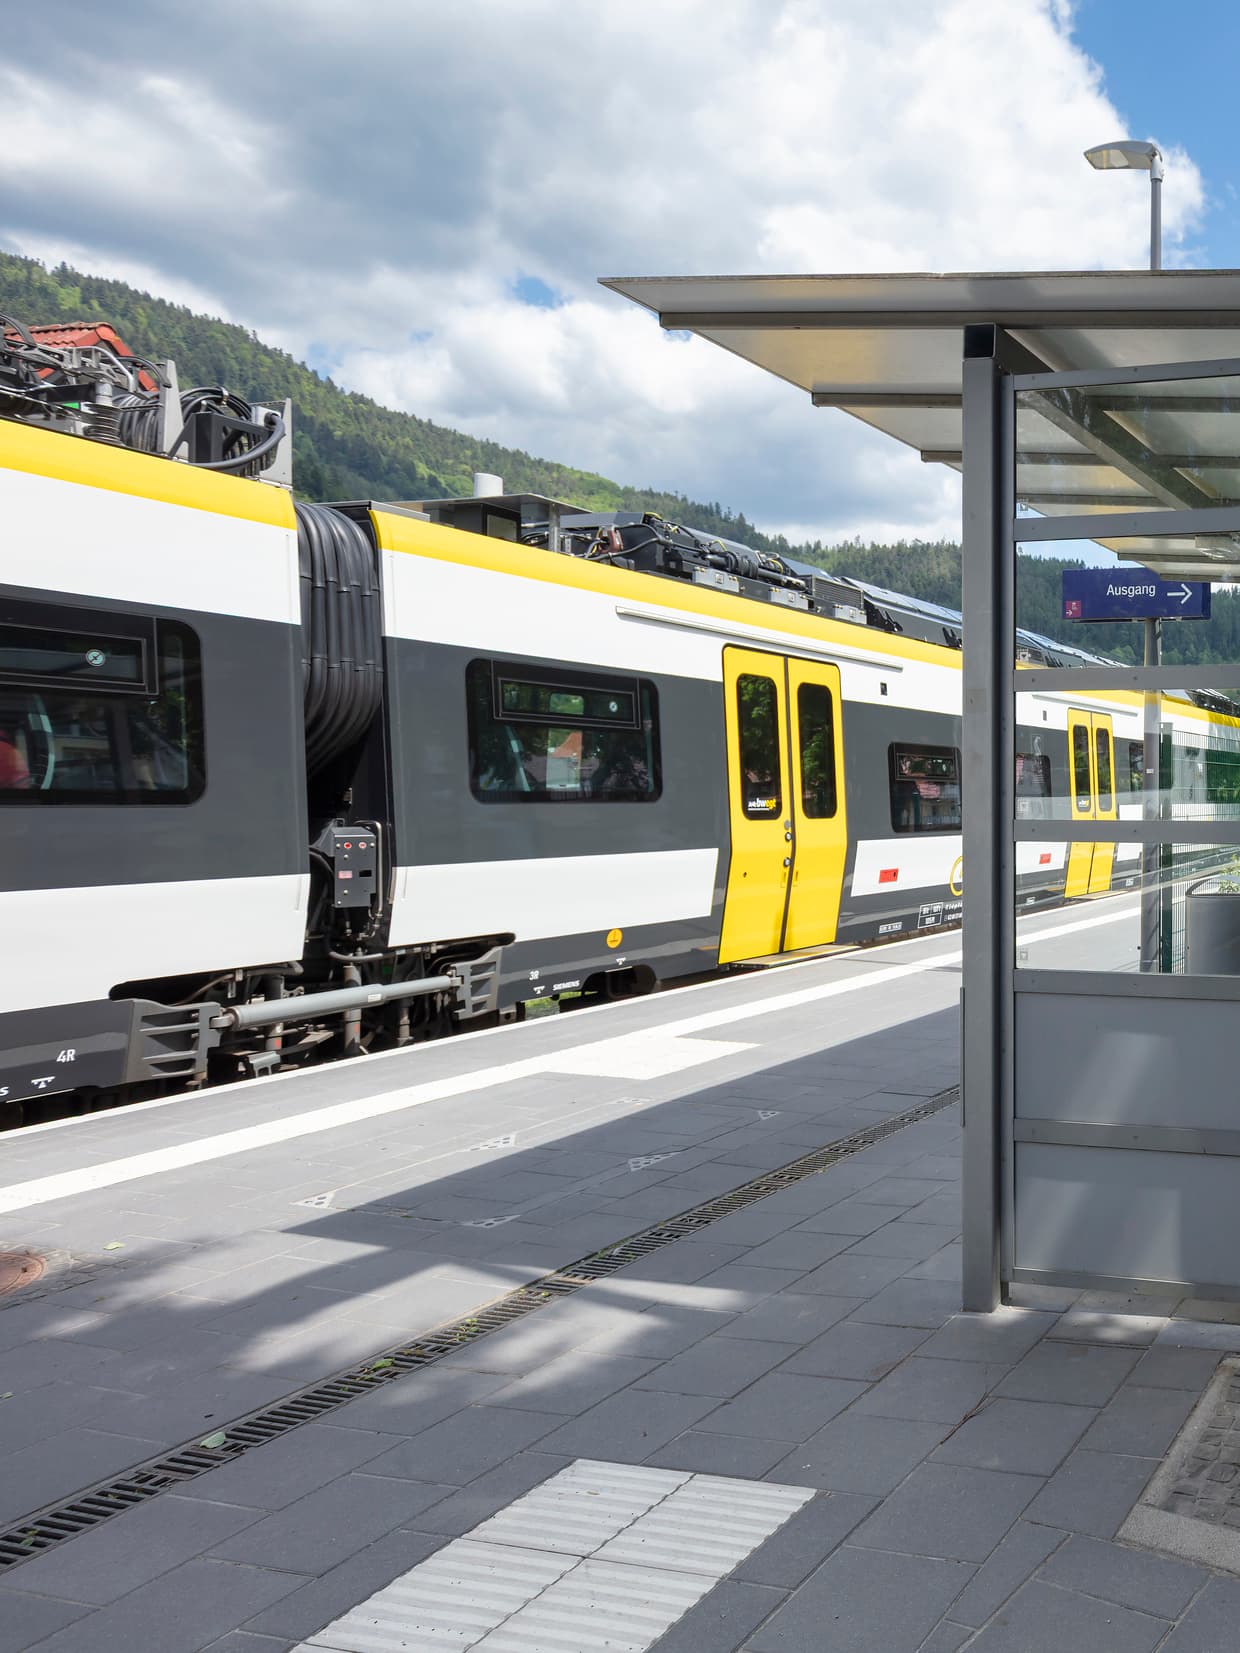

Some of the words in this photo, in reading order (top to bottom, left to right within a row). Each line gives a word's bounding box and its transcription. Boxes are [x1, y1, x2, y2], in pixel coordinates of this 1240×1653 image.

[1106, 584, 1156, 598] Ausgang
[529, 970, 540, 981] 3R
[552, 980, 580, 991] SIEMENS
[55, 1048, 77, 1063] 4R
